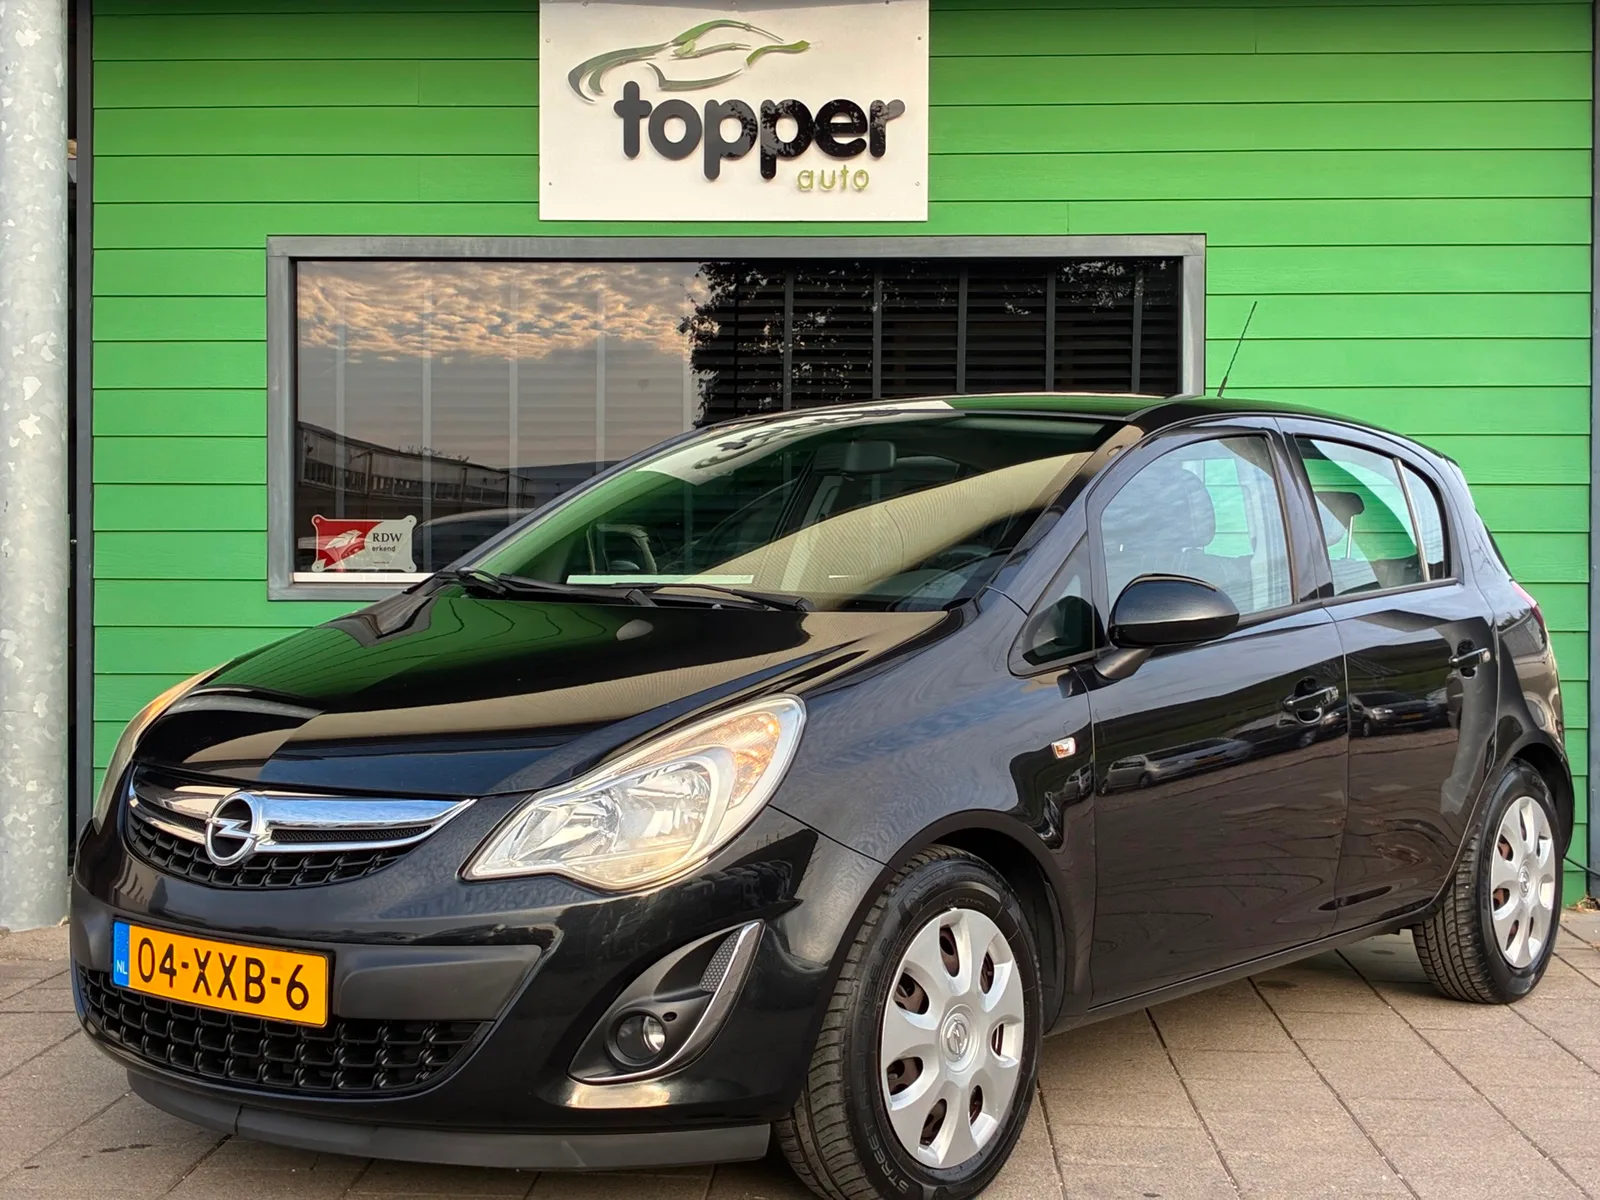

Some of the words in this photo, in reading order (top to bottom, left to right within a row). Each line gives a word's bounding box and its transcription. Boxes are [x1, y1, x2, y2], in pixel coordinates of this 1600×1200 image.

[614, 81, 905, 180] topper
[797, 164, 869, 190] auto
[372, 532, 402, 542] RDW
[116, 959, 128, 975] NL
[138, 937, 309, 1011] 04-XXB-6
[864, 1122, 909, 1194] STREET
